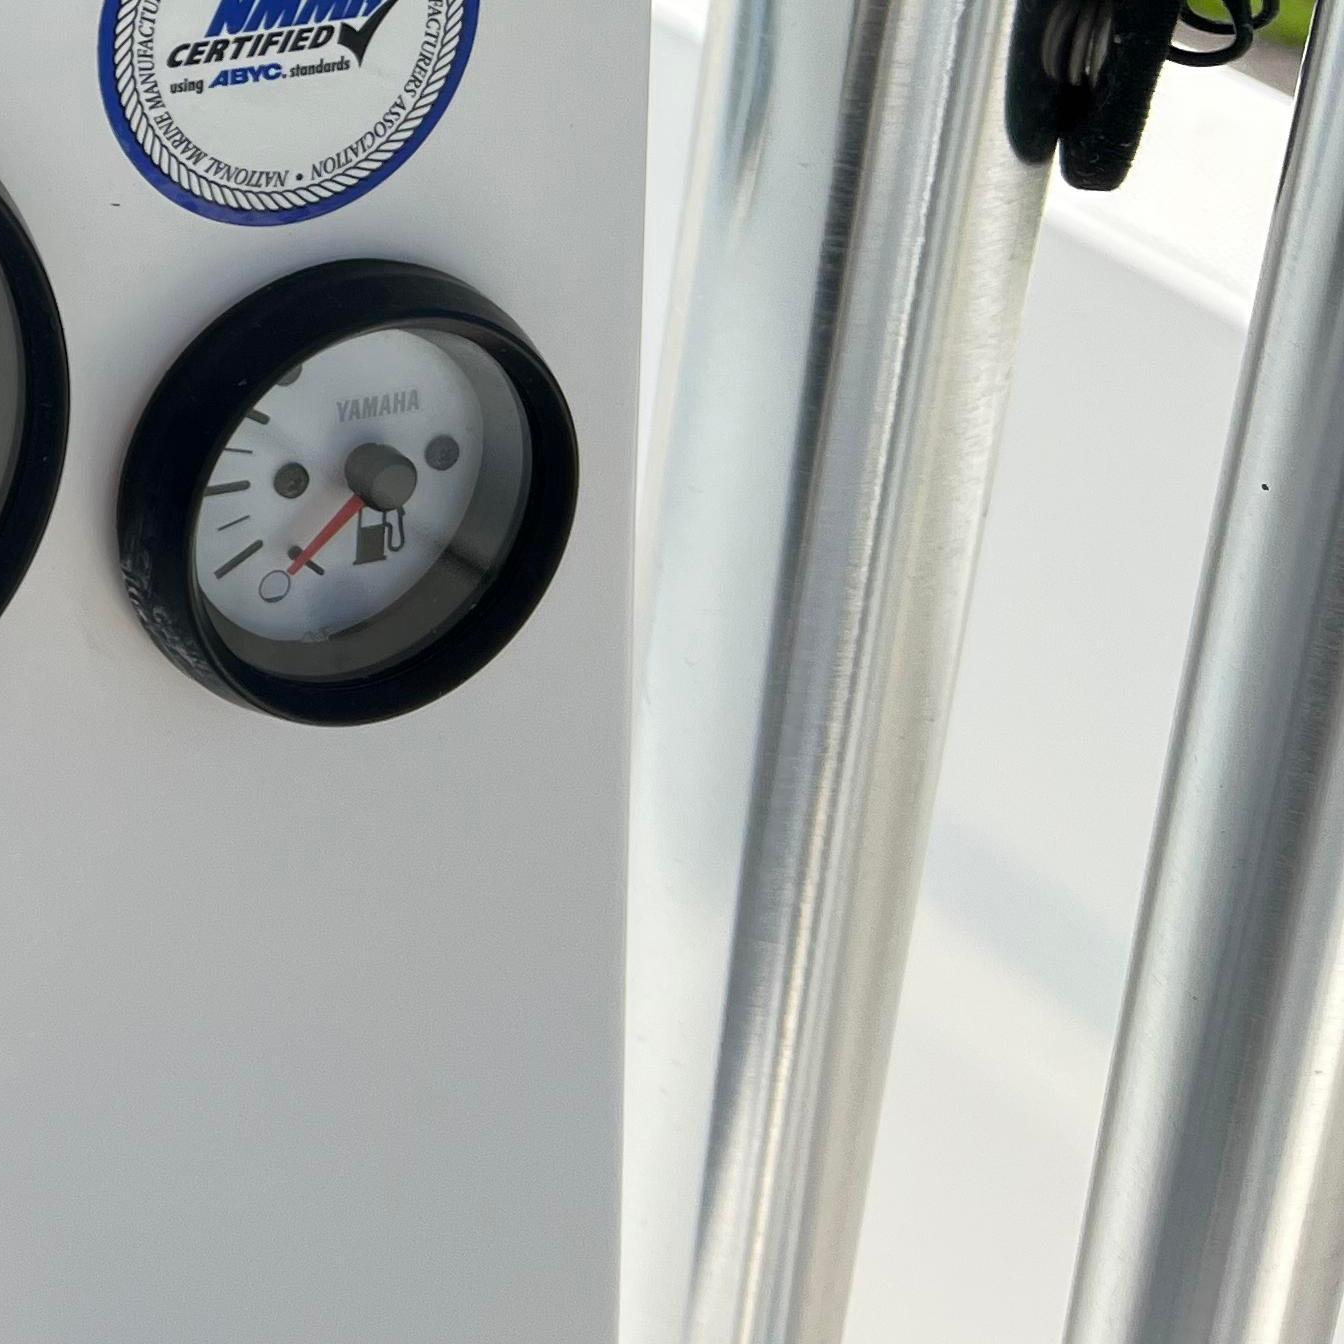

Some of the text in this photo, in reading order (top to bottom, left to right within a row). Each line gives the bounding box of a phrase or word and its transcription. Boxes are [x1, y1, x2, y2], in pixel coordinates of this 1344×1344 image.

[166, 25, 334, 69] CERTIFIED
[170, 78, 204, 94] using
[288, 56, 350, 78] standards
[153, 107, 210, 162] MARINE
[311, 96, 408, 182] ASSOCIATION
[204, 152, 289, 187] NATIONAL
[336, 389, 420, 424] YAMAHA
